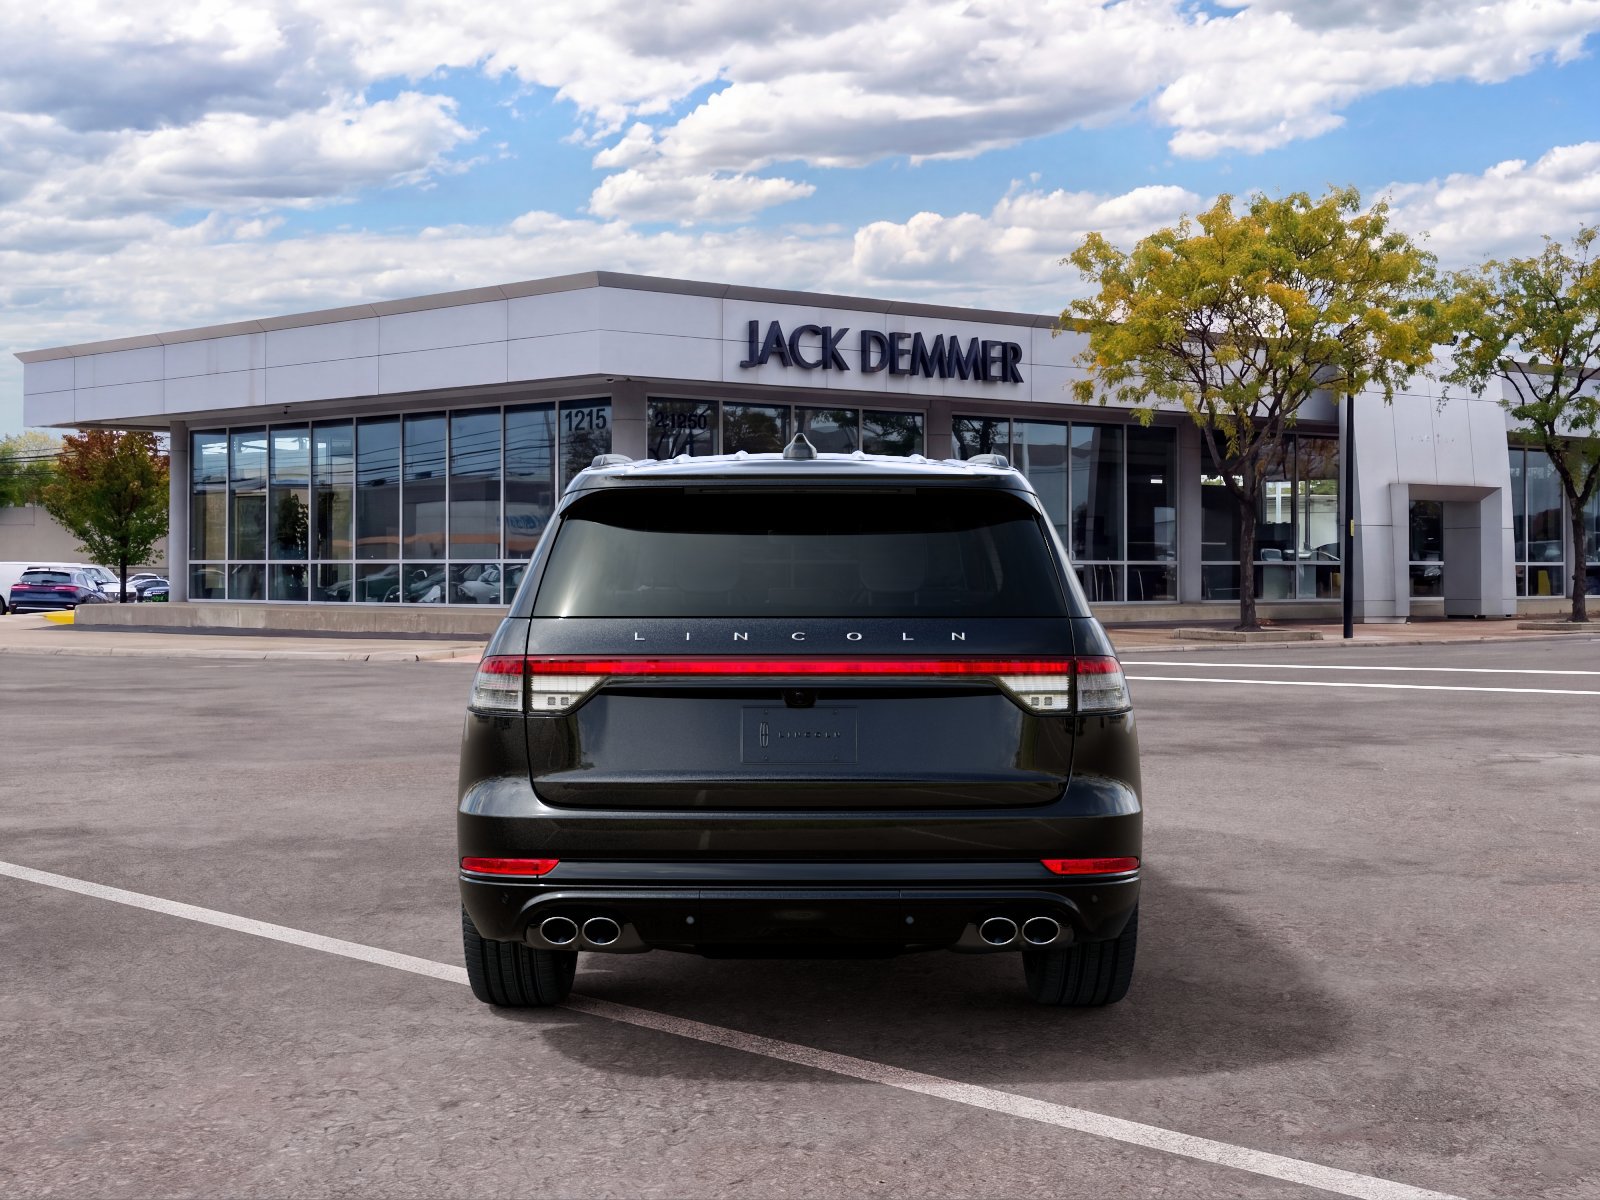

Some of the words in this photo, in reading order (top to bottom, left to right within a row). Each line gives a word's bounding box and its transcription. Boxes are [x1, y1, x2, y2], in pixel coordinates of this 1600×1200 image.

[740, 320, 850, 370] JACK
[860, 329, 1024, 383] DEMMER
[565, 408, 607, 431] 1215
[634, 632, 966, 641] LINCOLN
